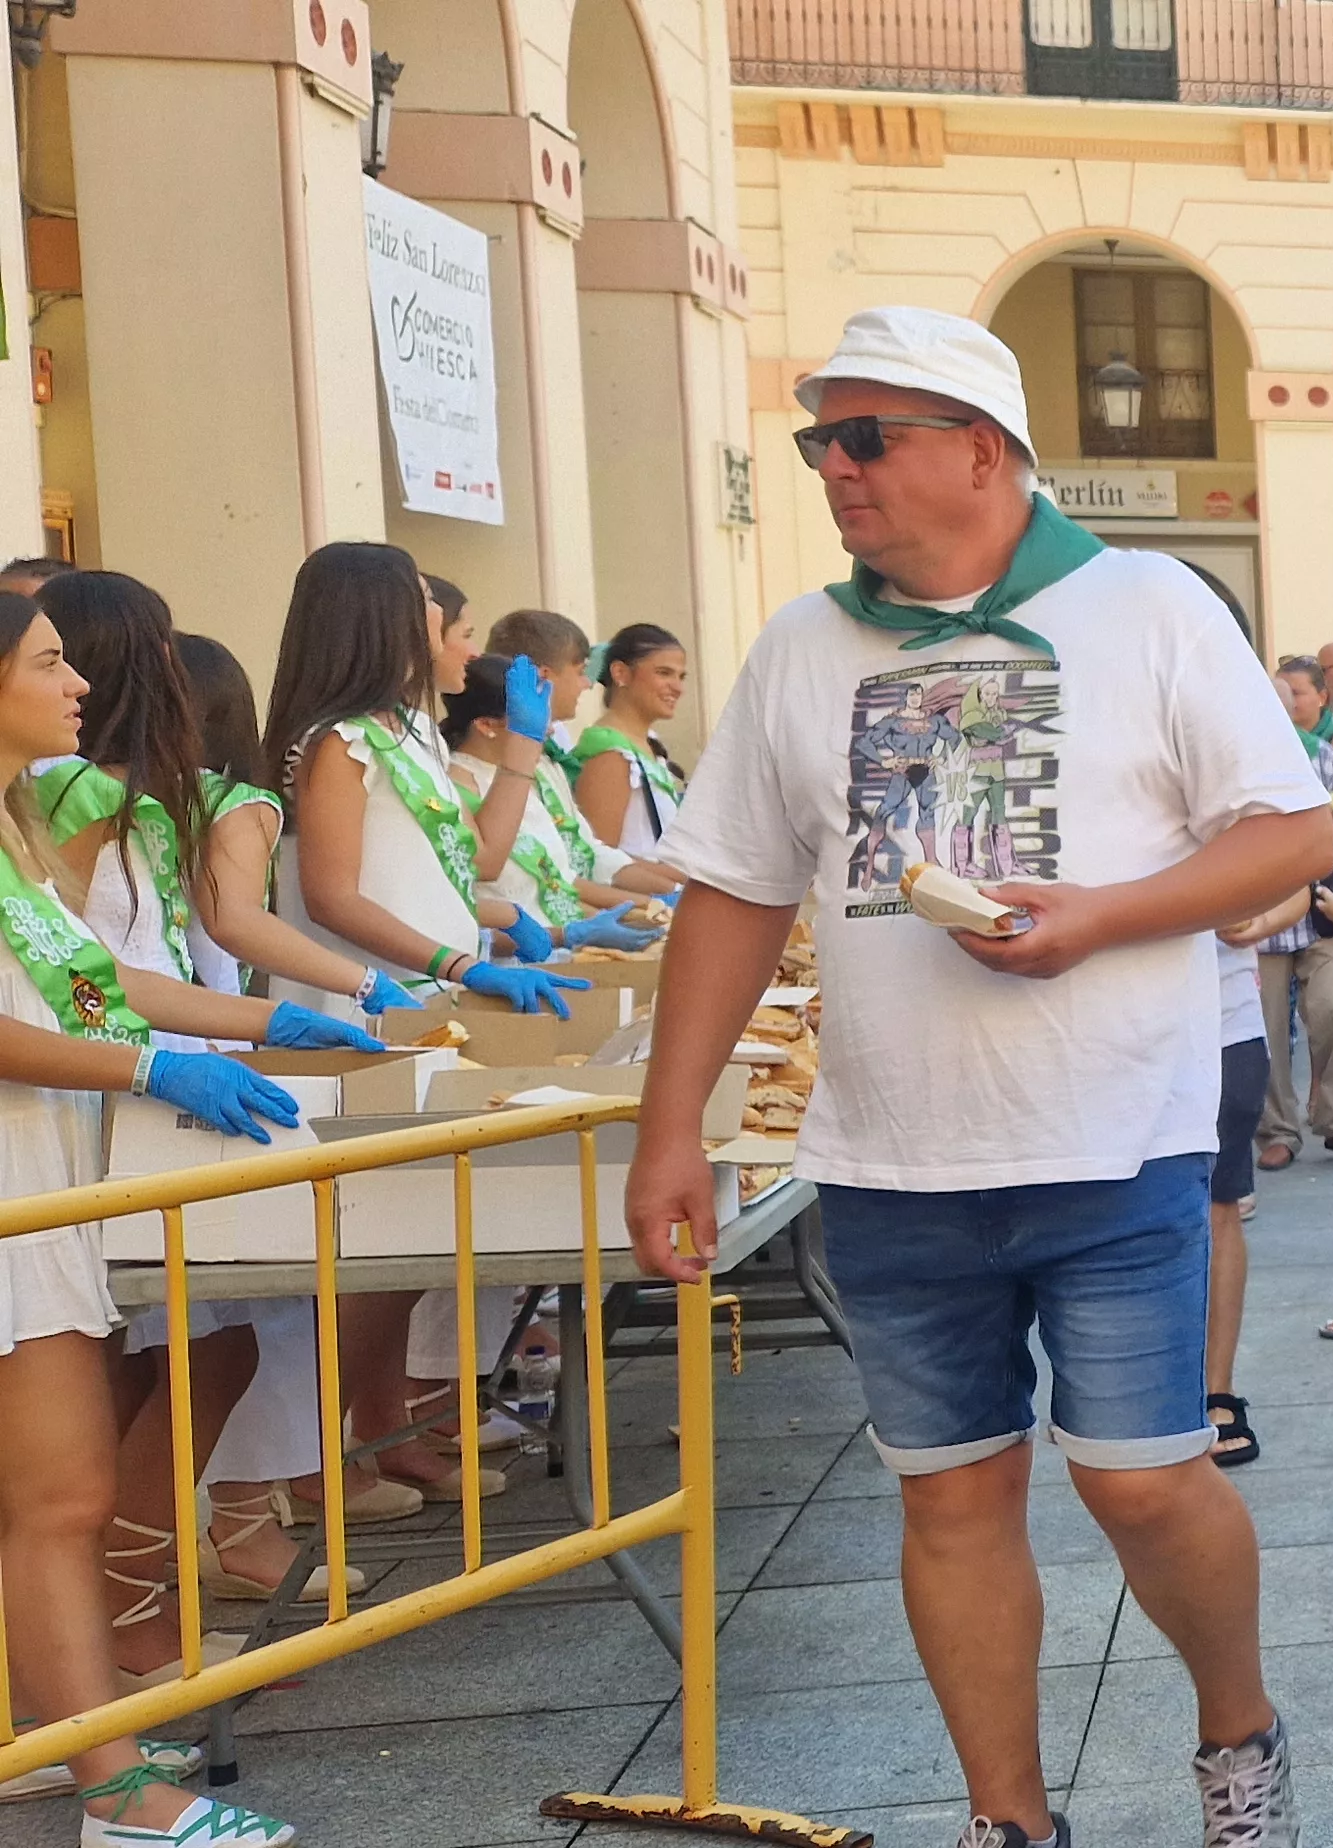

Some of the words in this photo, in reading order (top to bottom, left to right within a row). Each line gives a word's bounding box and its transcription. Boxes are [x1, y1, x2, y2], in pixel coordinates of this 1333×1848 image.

[366, 213, 398, 261] Feliz
[402, 229, 428, 273] San
[431, 242, 487, 297] Lorenzo
[414, 307, 474, 349] COMERCIO
[416, 340, 478, 380] HUESCA
